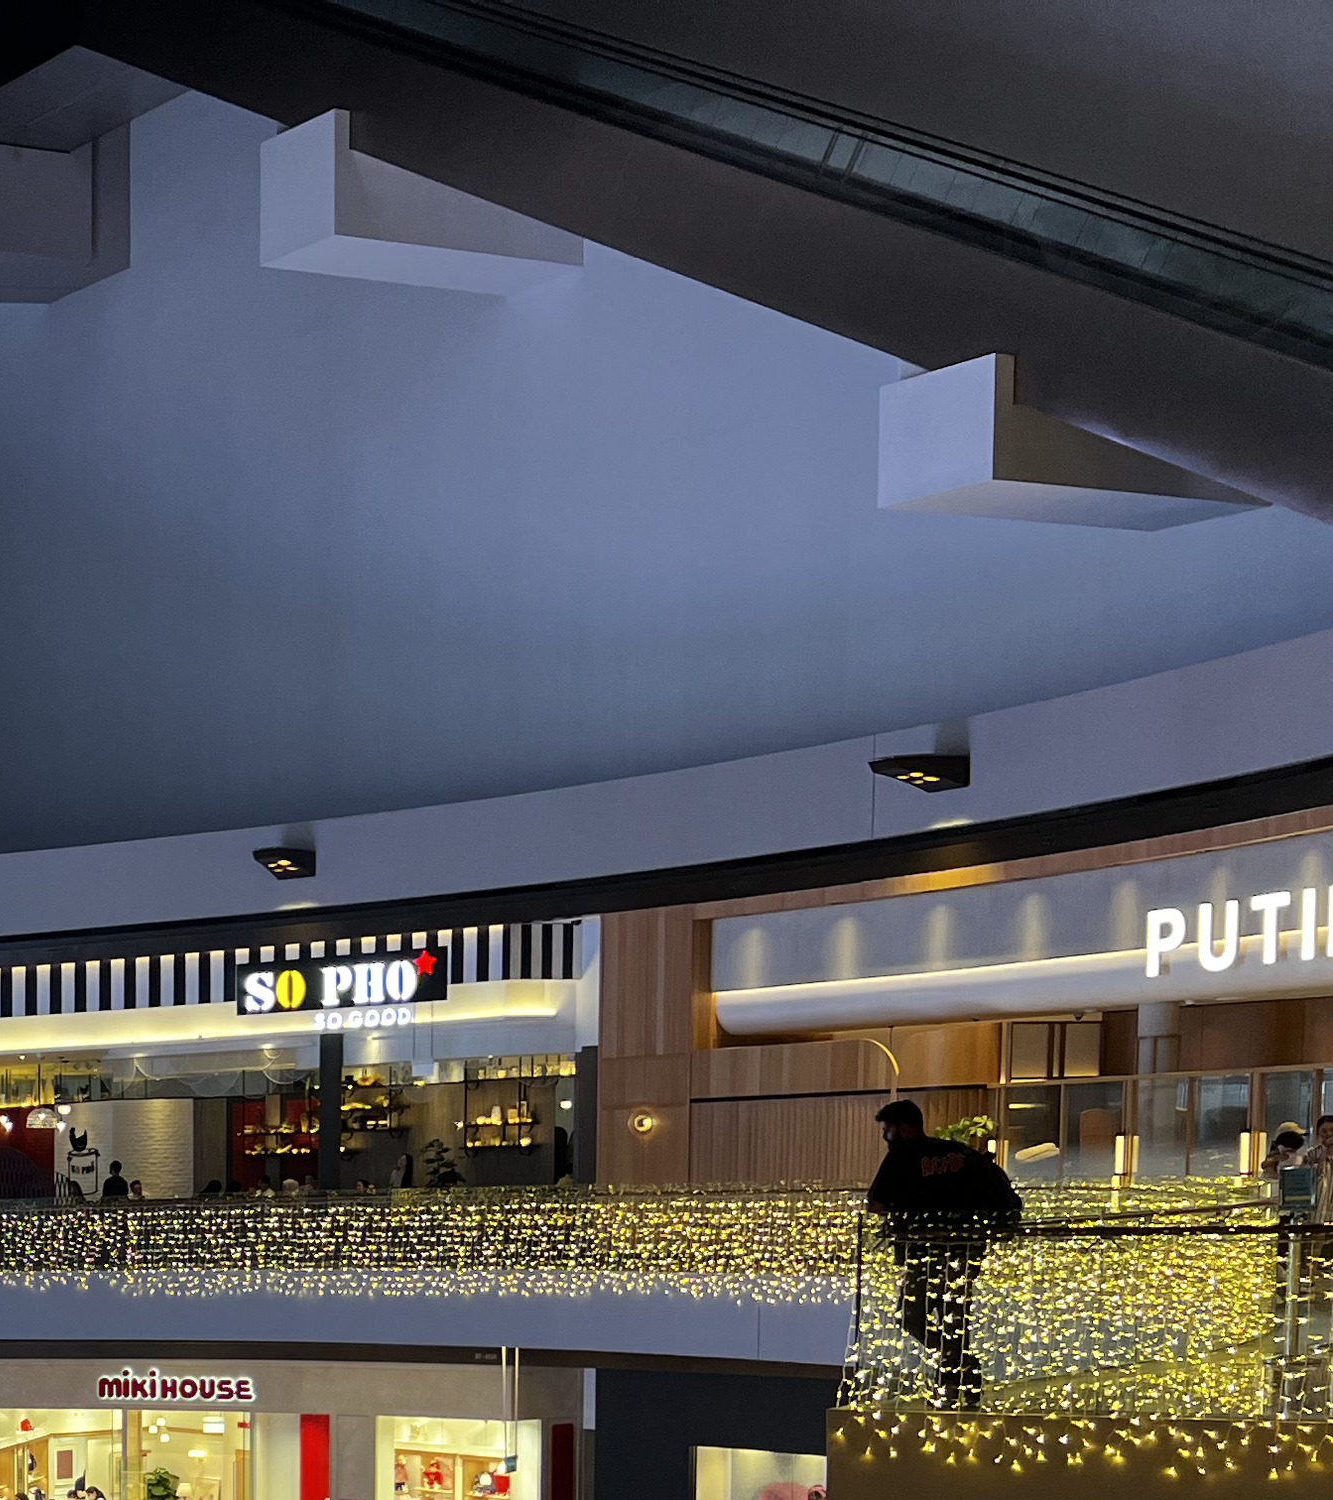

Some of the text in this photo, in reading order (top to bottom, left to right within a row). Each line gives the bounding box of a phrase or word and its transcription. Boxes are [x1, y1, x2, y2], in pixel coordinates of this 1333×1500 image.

[1146, 887, 1333, 978] PUTI
[244, 960, 418, 1012] SO PHO
[313, 1007, 412, 1030] SO GOOD
